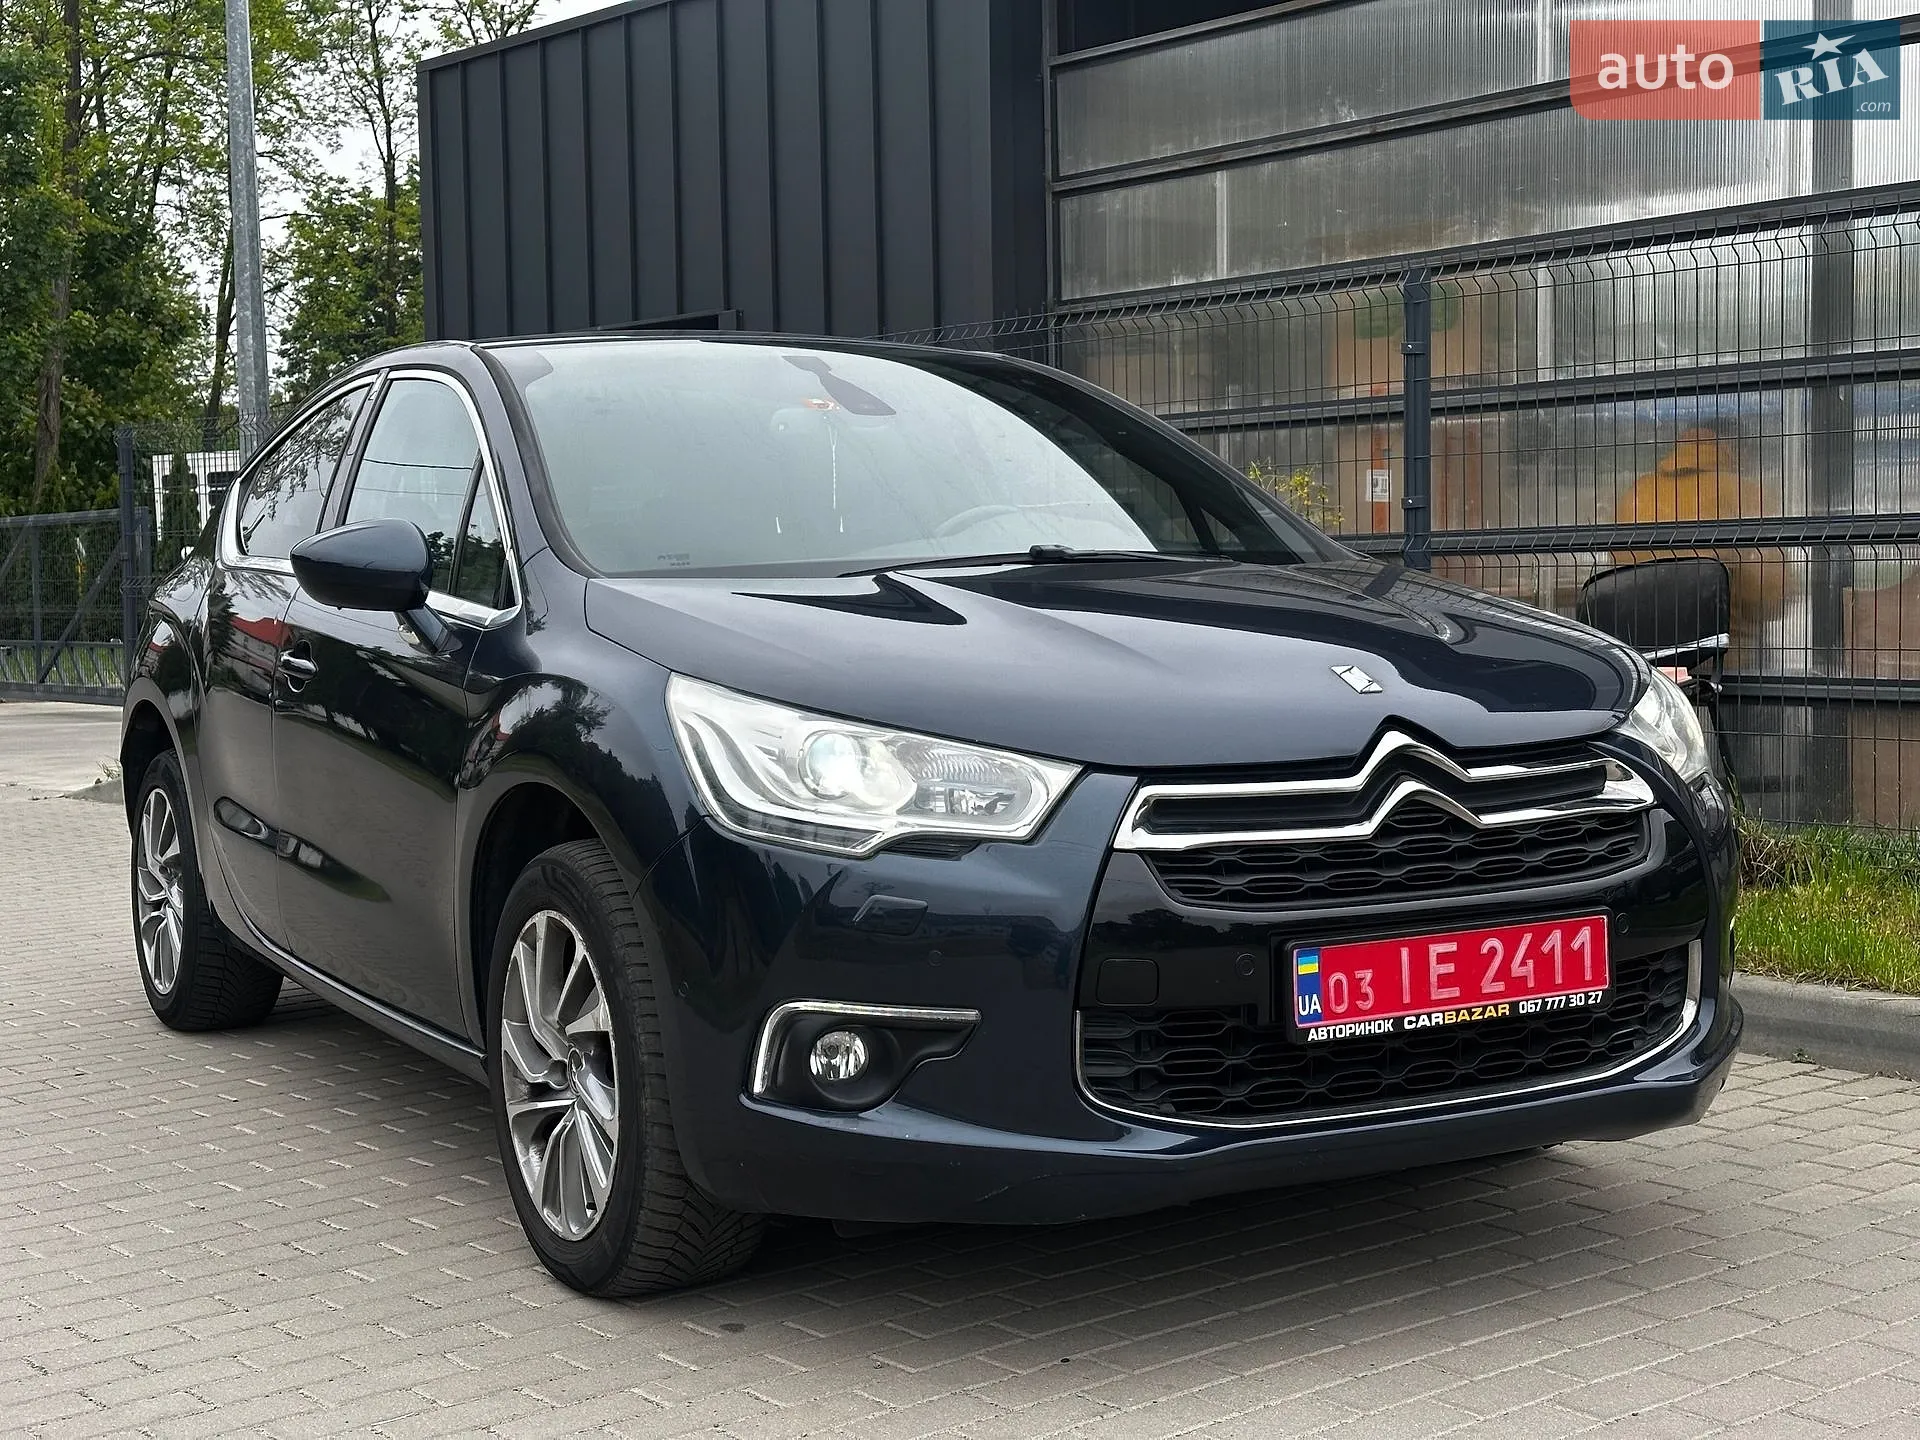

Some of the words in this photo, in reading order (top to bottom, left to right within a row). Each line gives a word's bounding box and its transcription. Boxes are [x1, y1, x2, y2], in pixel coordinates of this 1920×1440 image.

[1328, 969, 1375, 1014] 03
[1400, 941, 1461, 1005] IE
[1479, 926, 1593, 995] 2411
[1298, 993, 1322, 1016] UA
[1307, 1018, 1394, 1042] АВТОРИНОК
[1403, 1003, 1510, 1030] CARBAZAR
[1518, 999, 1542, 1014] 067
[1544, 996, 1566, 1010] 777
[1568, 993, 1585, 1007] 30
[1587, 990, 1603, 1004] 27
